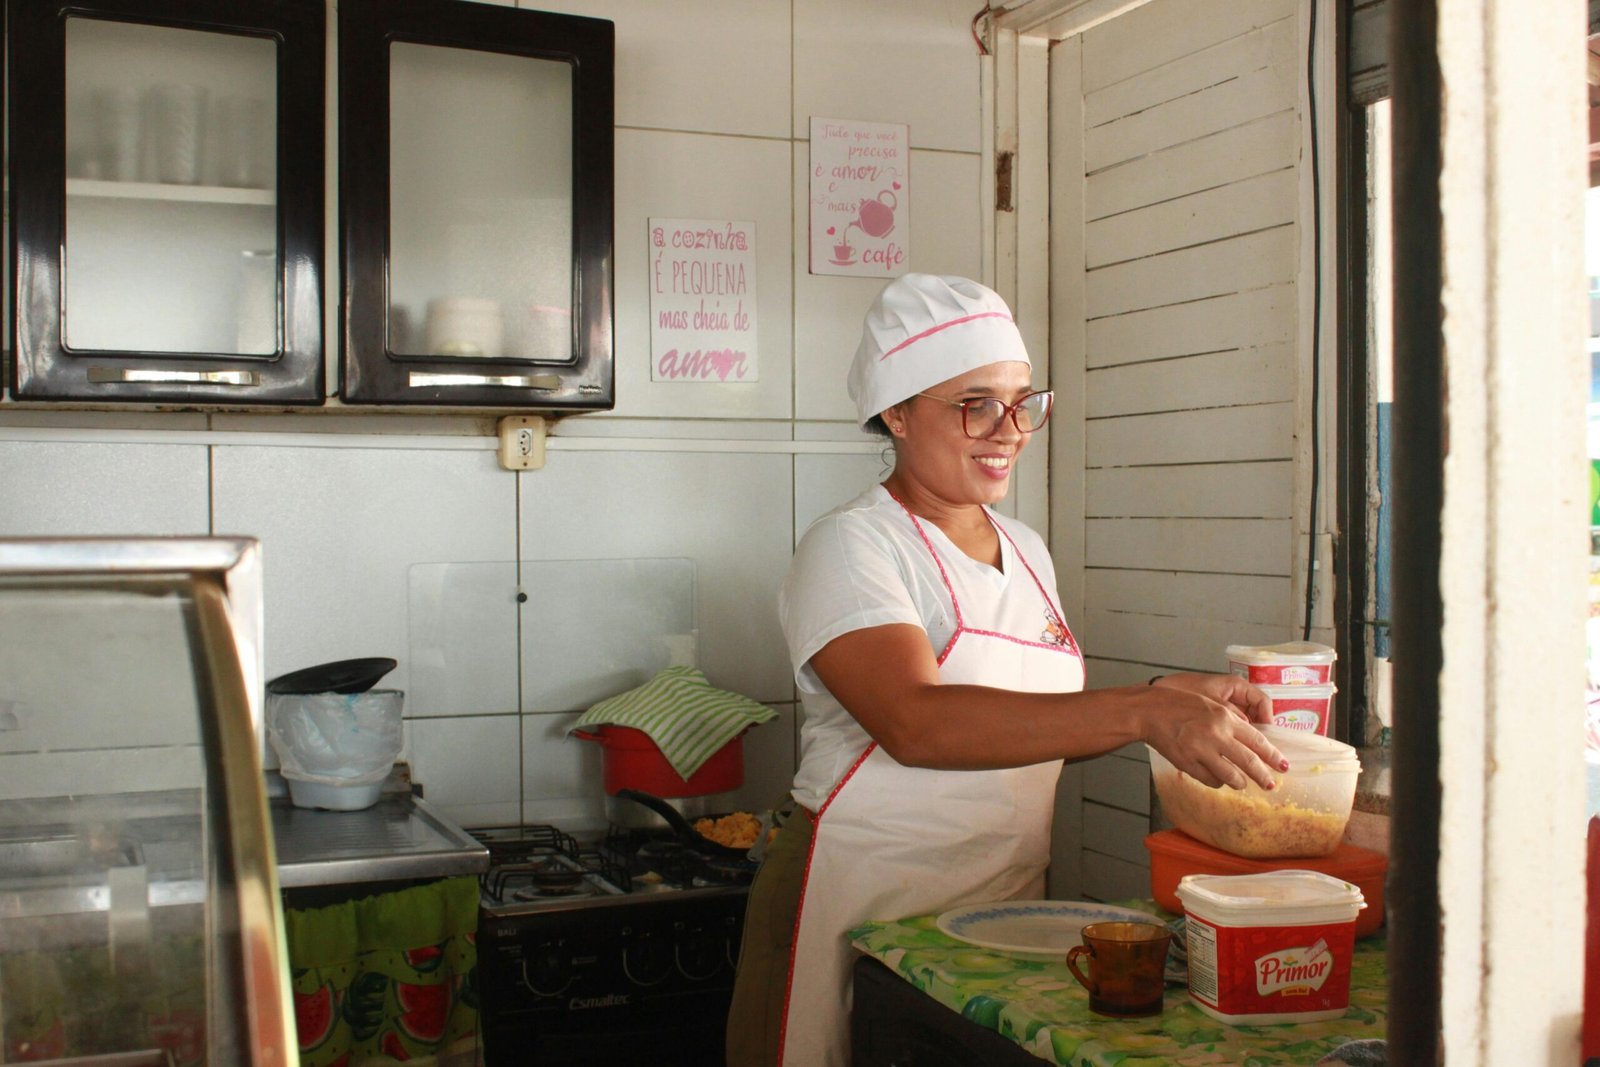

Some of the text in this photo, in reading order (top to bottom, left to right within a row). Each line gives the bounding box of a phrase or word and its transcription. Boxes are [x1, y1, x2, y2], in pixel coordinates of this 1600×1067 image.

[848, 145, 897, 160] precisa
[832, 165, 880, 182] amor
[828, 181, 838, 193] e
[827, 201, 857, 213] mais
[652, 222, 748, 251] a cozinha
[862, 242, 904, 270] café
[655, 250, 747, 296] É PEQUENA
[658, 300, 750, 332] mas cheia de
[1260, 957, 1329, 986] Primor
[568, 994, 630, 1011] Esmaltec
